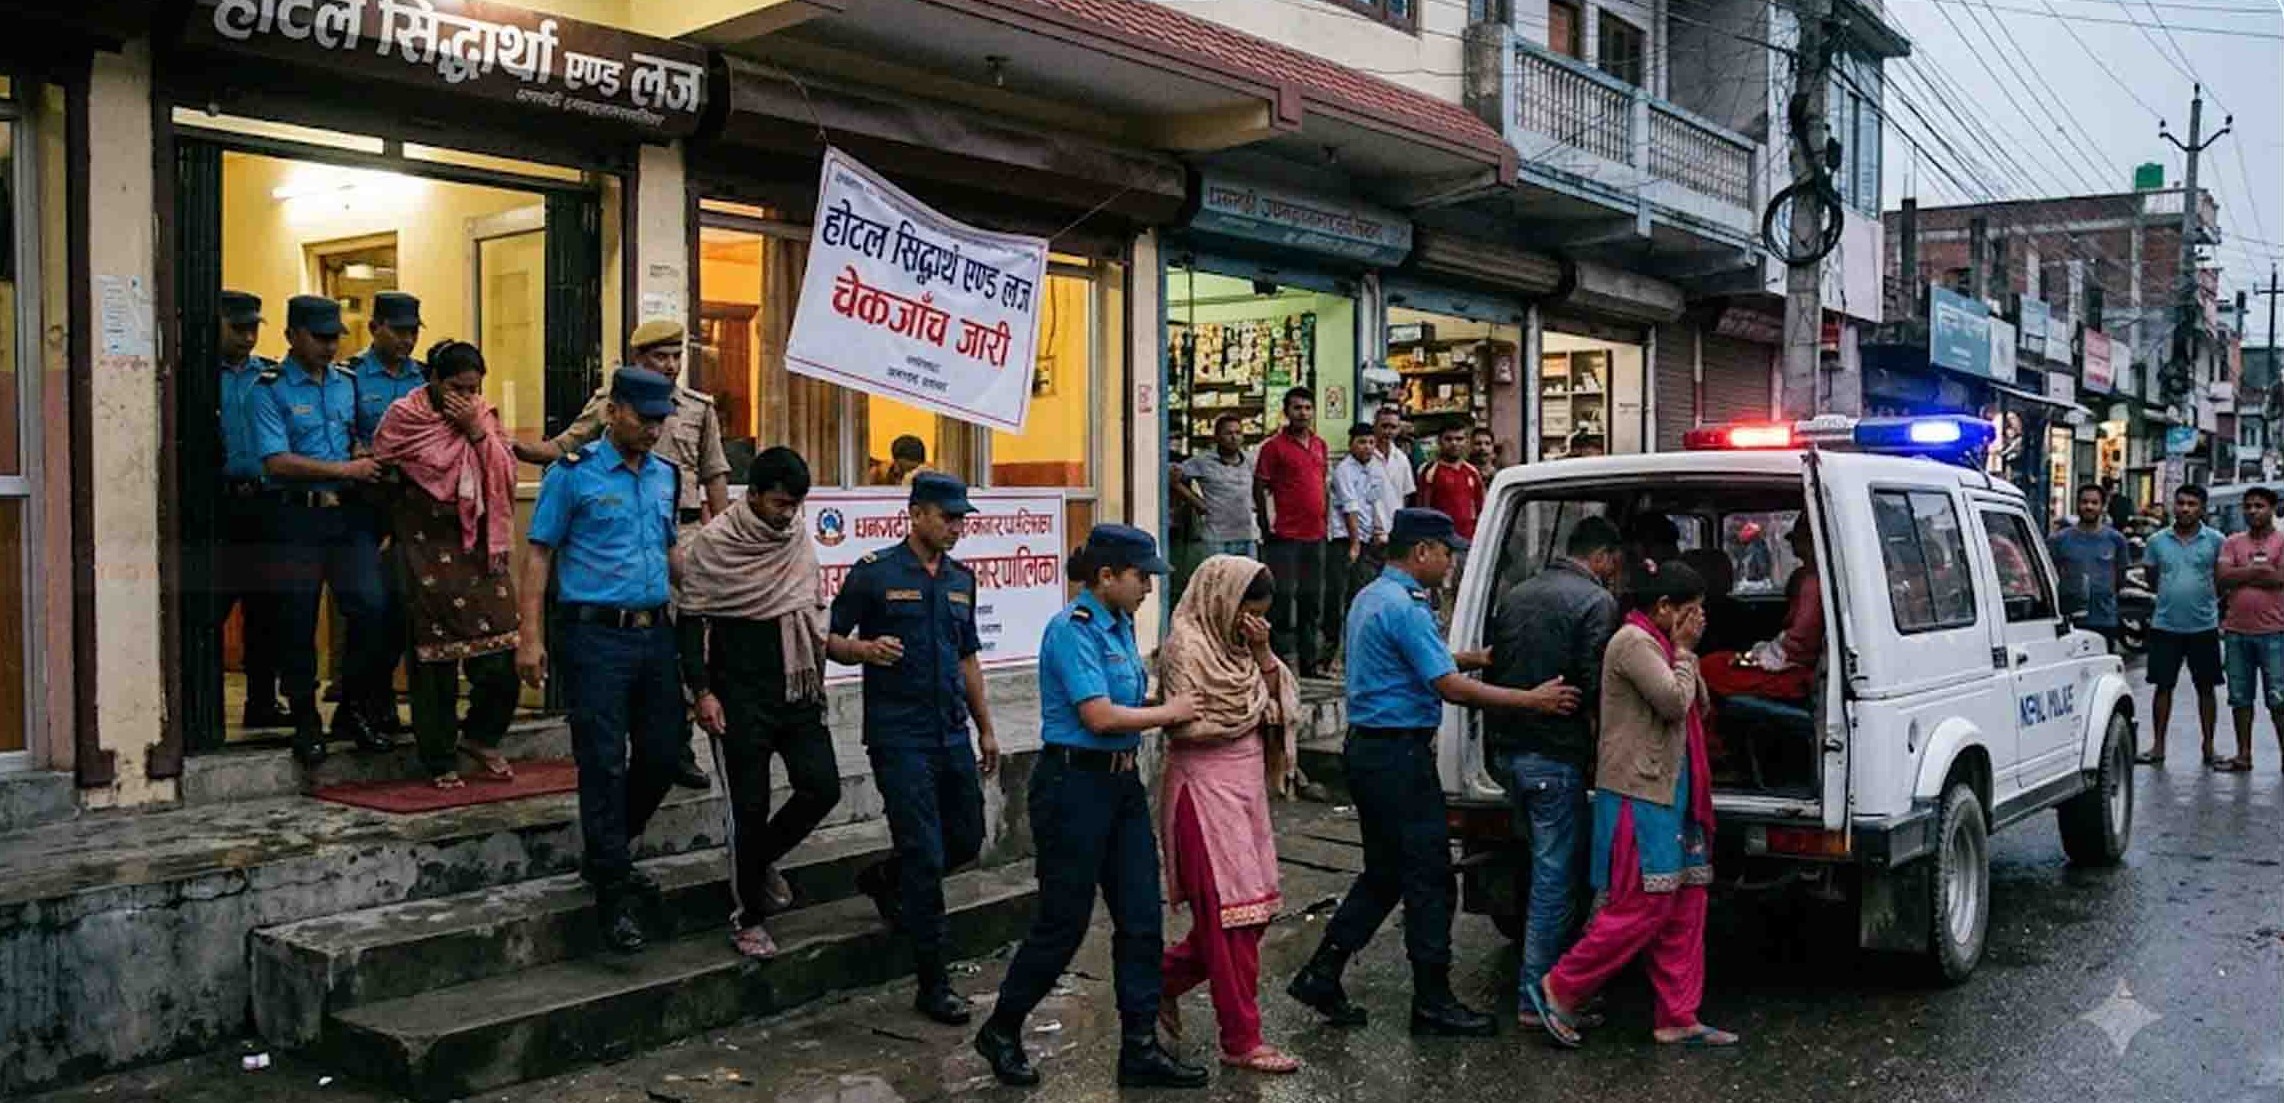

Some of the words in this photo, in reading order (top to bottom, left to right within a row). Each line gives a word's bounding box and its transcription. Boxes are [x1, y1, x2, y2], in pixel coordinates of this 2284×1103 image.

[564, 51, 625, 97] एण्ड
[630, 52, 704, 113] लज
[822, 199, 890, 260] होटल
[963, 258, 1000, 300] एण्ड
[832, 265, 951, 347] चेकजाँच
[955, 318, 1012, 368] जारी
